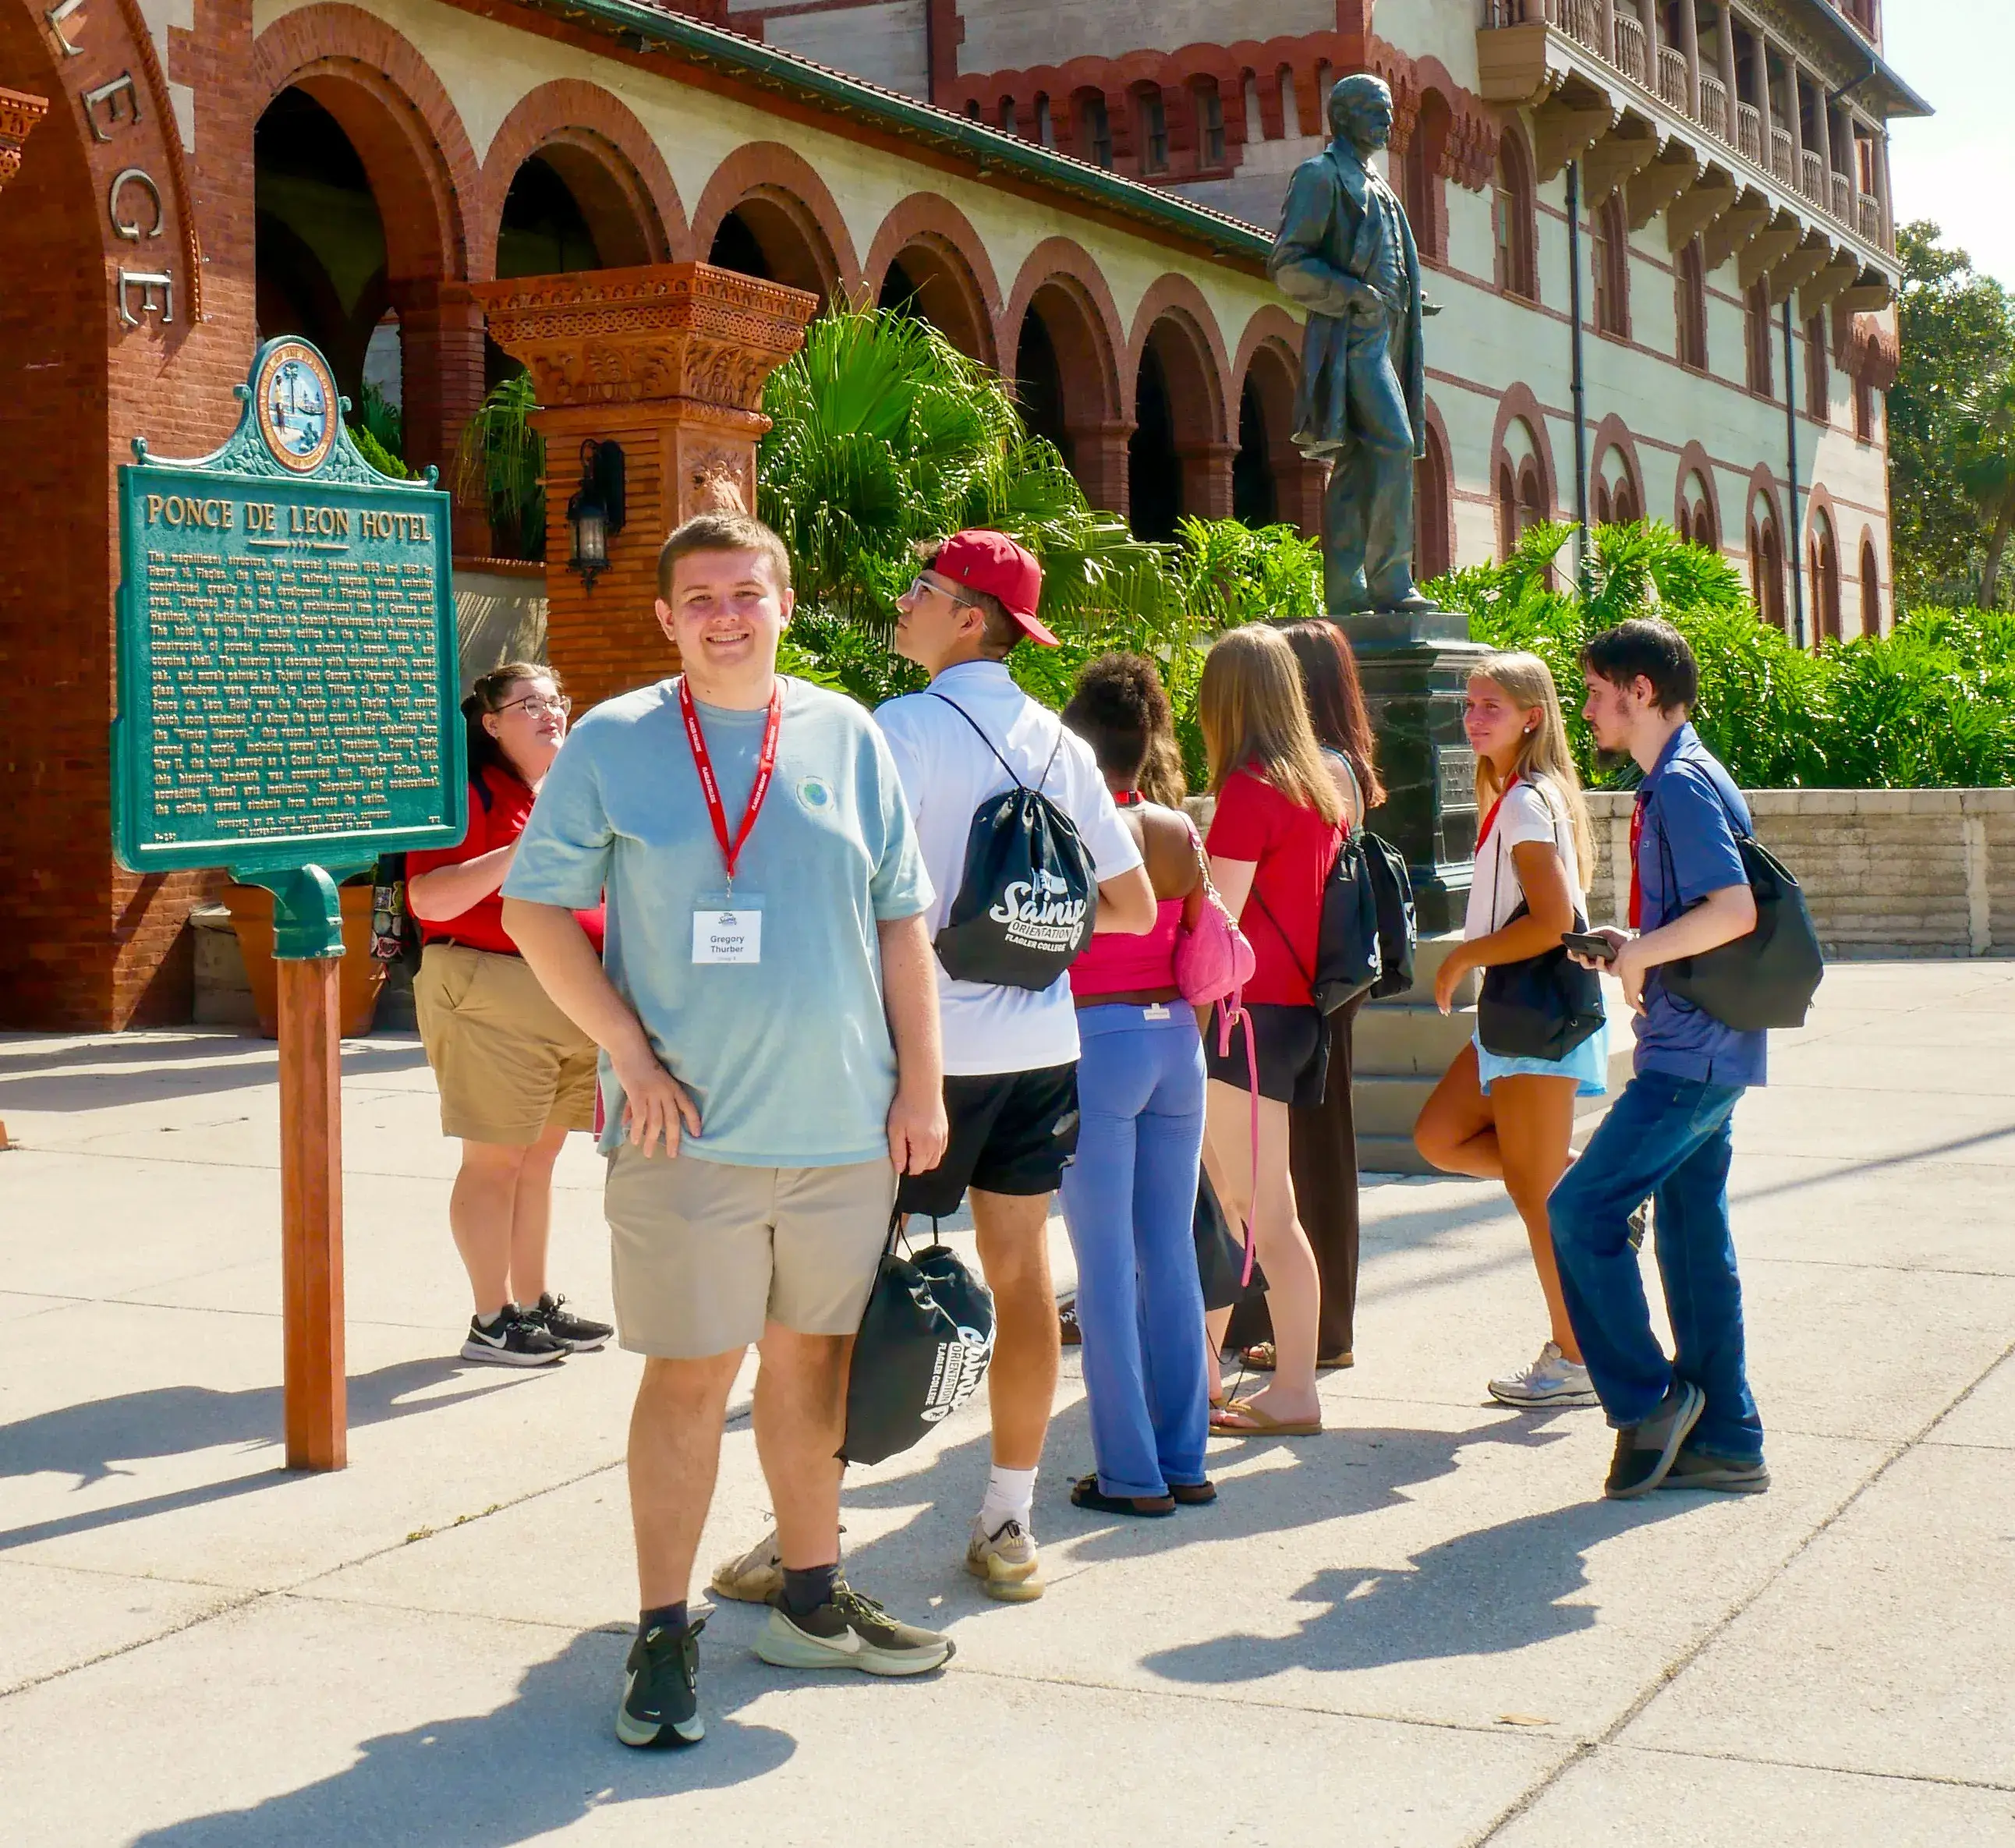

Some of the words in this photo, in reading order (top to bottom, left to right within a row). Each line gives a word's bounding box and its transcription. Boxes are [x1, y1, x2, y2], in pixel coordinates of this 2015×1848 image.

[147, 495, 234, 529] PONCE
[246, 503, 276, 531] DE
[291, 505, 349, 536] LEON
[362, 511, 431, 541] HOTEL
[1004, 933, 1037, 949] FLAGLER
[1037, 942, 1067, 952] COLLEGE
[1011, 922, 1070, 940] ORIENTATION
[933, 1343, 947, 1375] FLAGLER
[940, 1345, 962, 1402] ORIENTATION
[926, 1375, 940, 1406] COLLEGE
